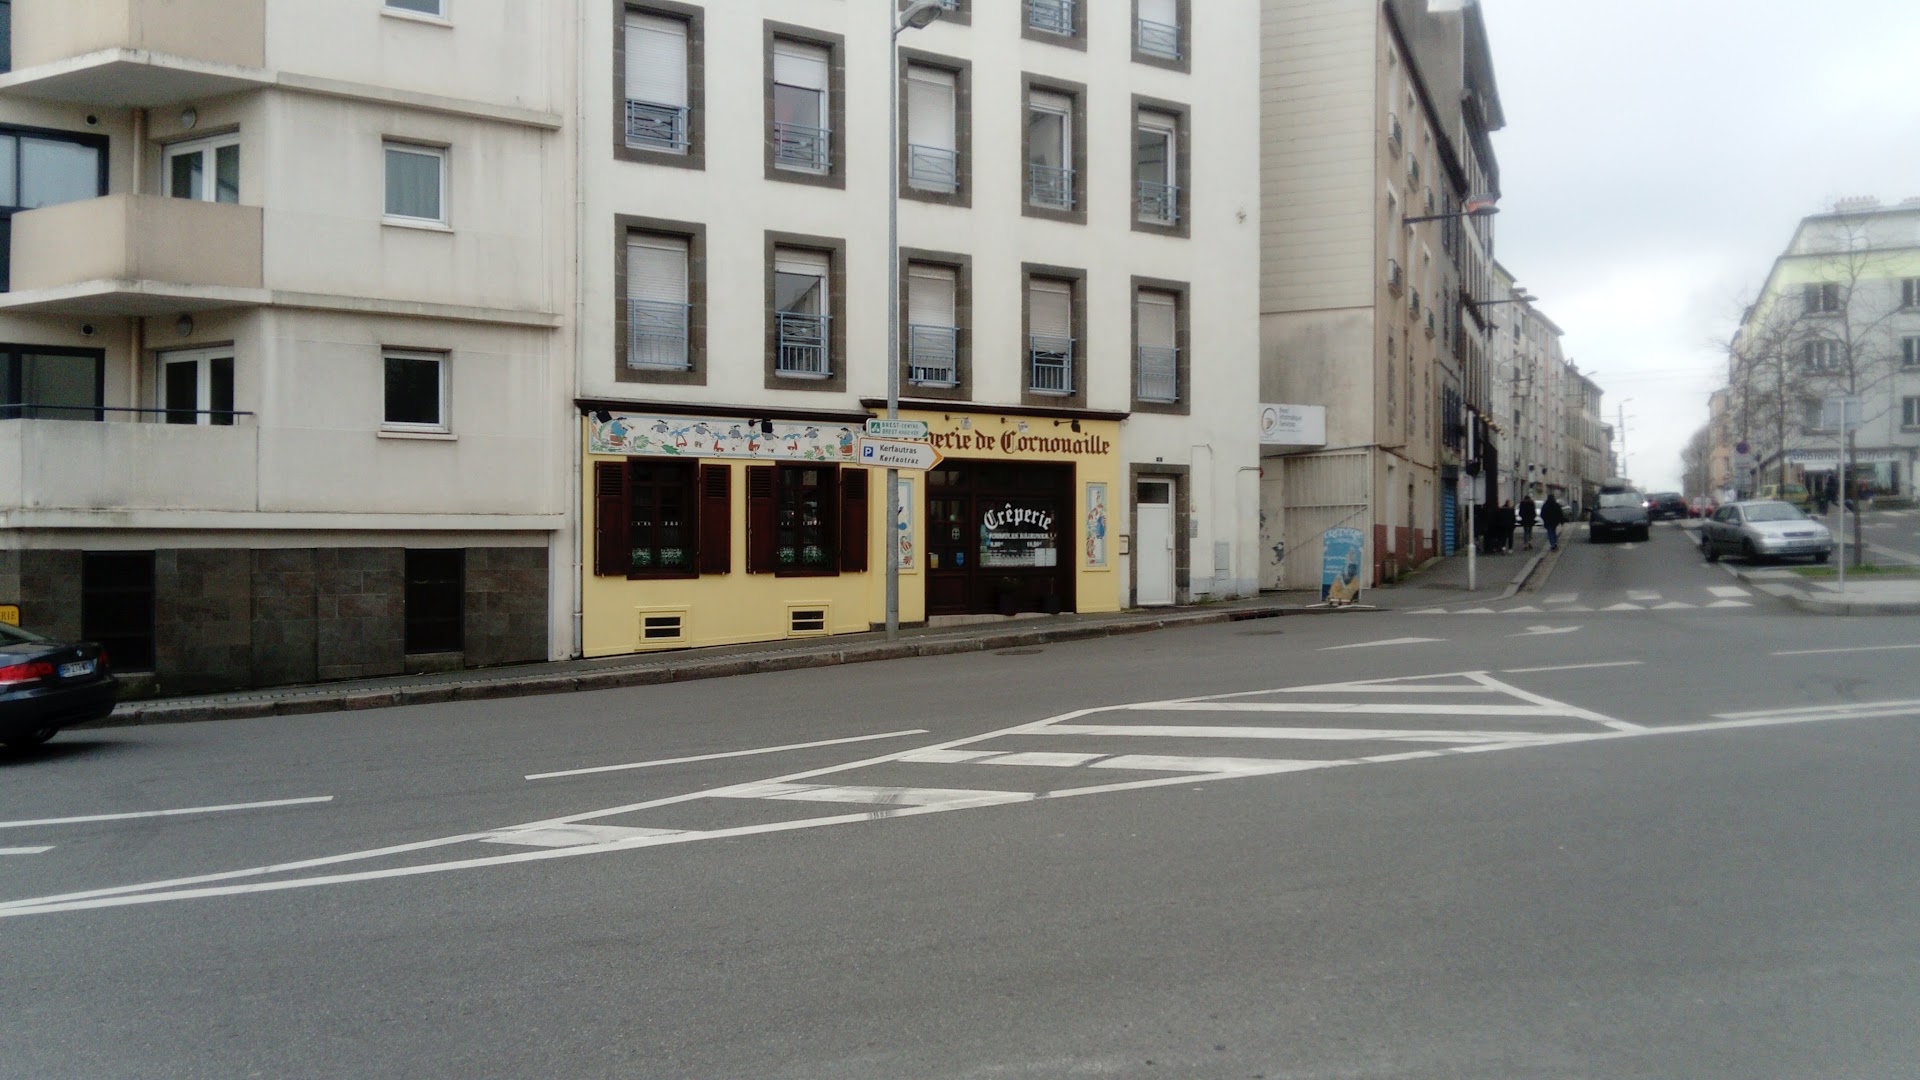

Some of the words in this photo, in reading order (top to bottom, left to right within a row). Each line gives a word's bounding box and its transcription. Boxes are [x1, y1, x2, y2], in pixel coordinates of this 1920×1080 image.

[975, 429, 996, 450] de
[1000, 429, 1110, 455] Cornouaille
[880, 444, 917, 454] Kerfautras
[880, 454, 919, 464] Kerfaotraz
[984, 502, 1052, 531] Crêperie
[1, 610, 16, 620] RIE
